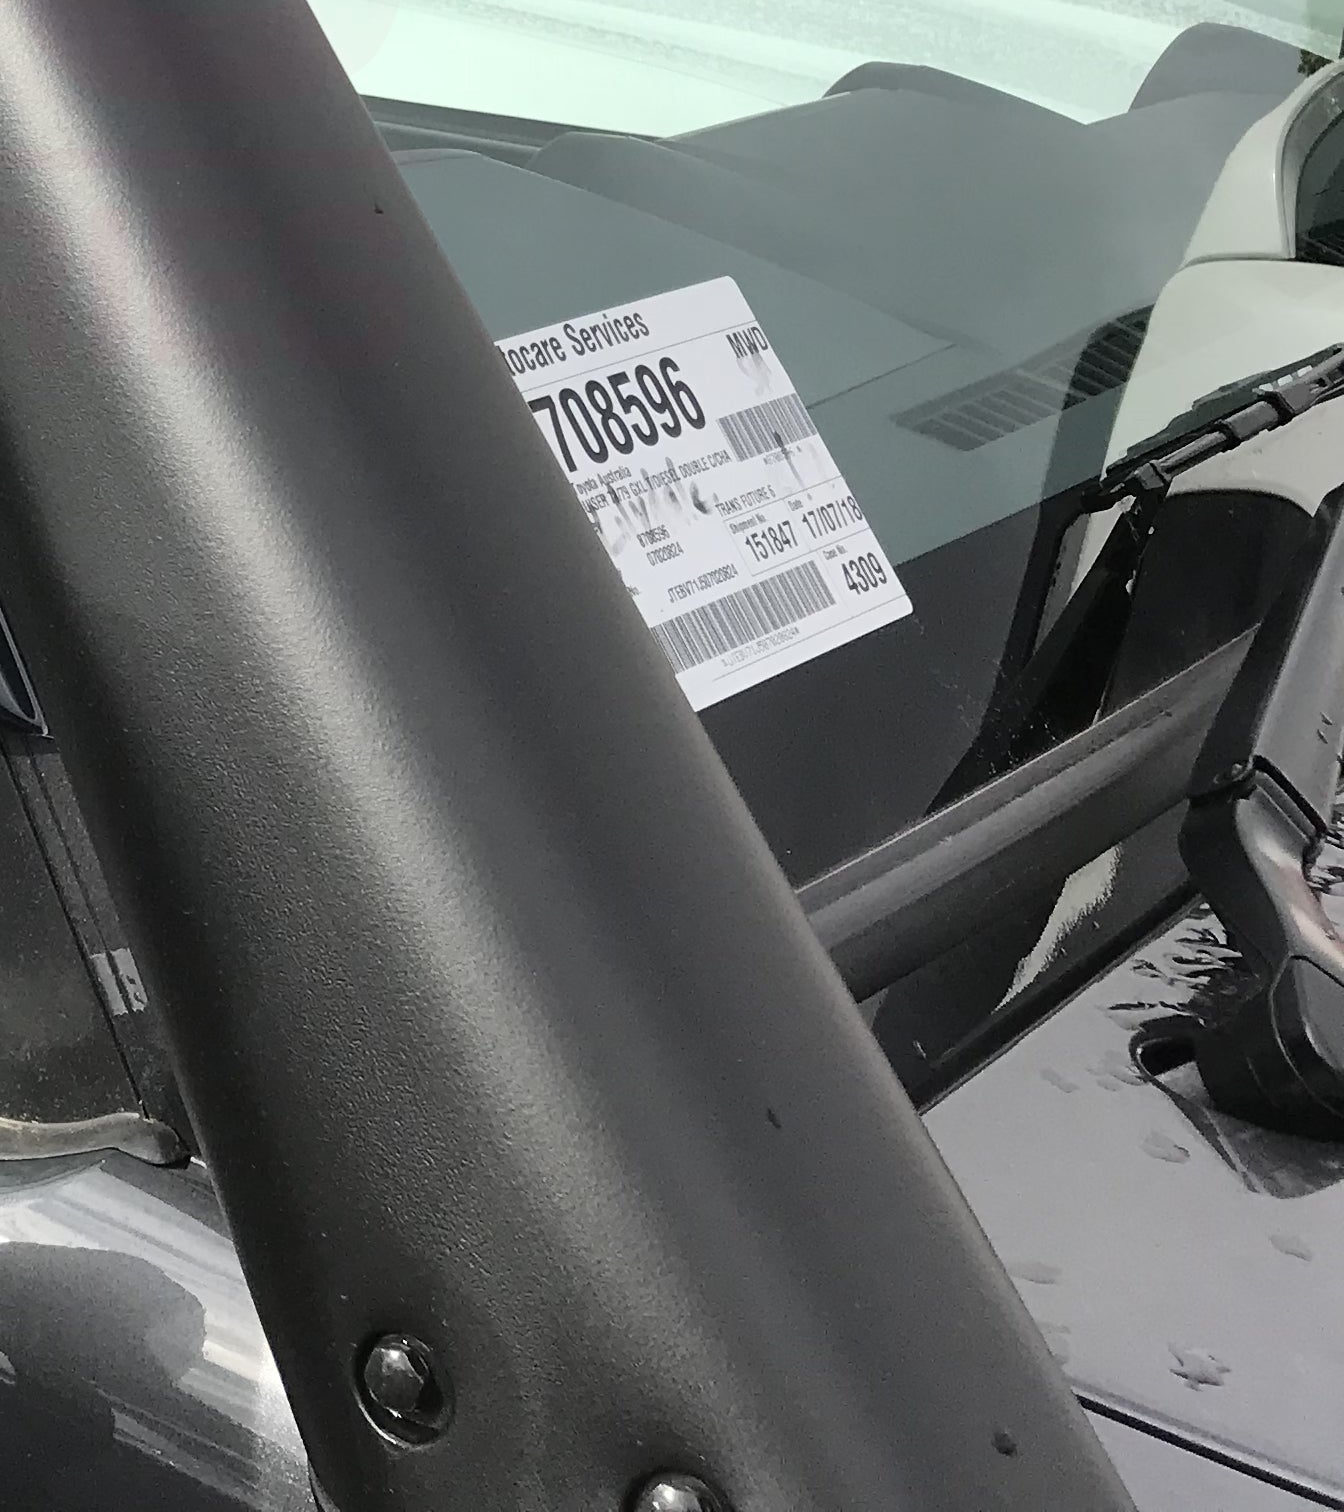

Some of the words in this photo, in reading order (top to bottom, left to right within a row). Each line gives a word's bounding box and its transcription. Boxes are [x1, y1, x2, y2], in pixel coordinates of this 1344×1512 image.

[564, 312, 650, 356] Services
[726, 326, 769, 359] MWD
[528, 356, 706, 473] 708596
[597, 466, 632, 487] Australia
[631, 480, 649, 497] GXL
[680, 458, 710, 479] DOUBLE
[715, 498, 740, 517] TRANS
[739, 487, 771, 510] FUTURE
[788, 498, 803, 511] Date
[802, 495, 863, 539] 17/07/18
[745, 520, 798, 562] 151847
[841, 552, 888, 595] 4309
